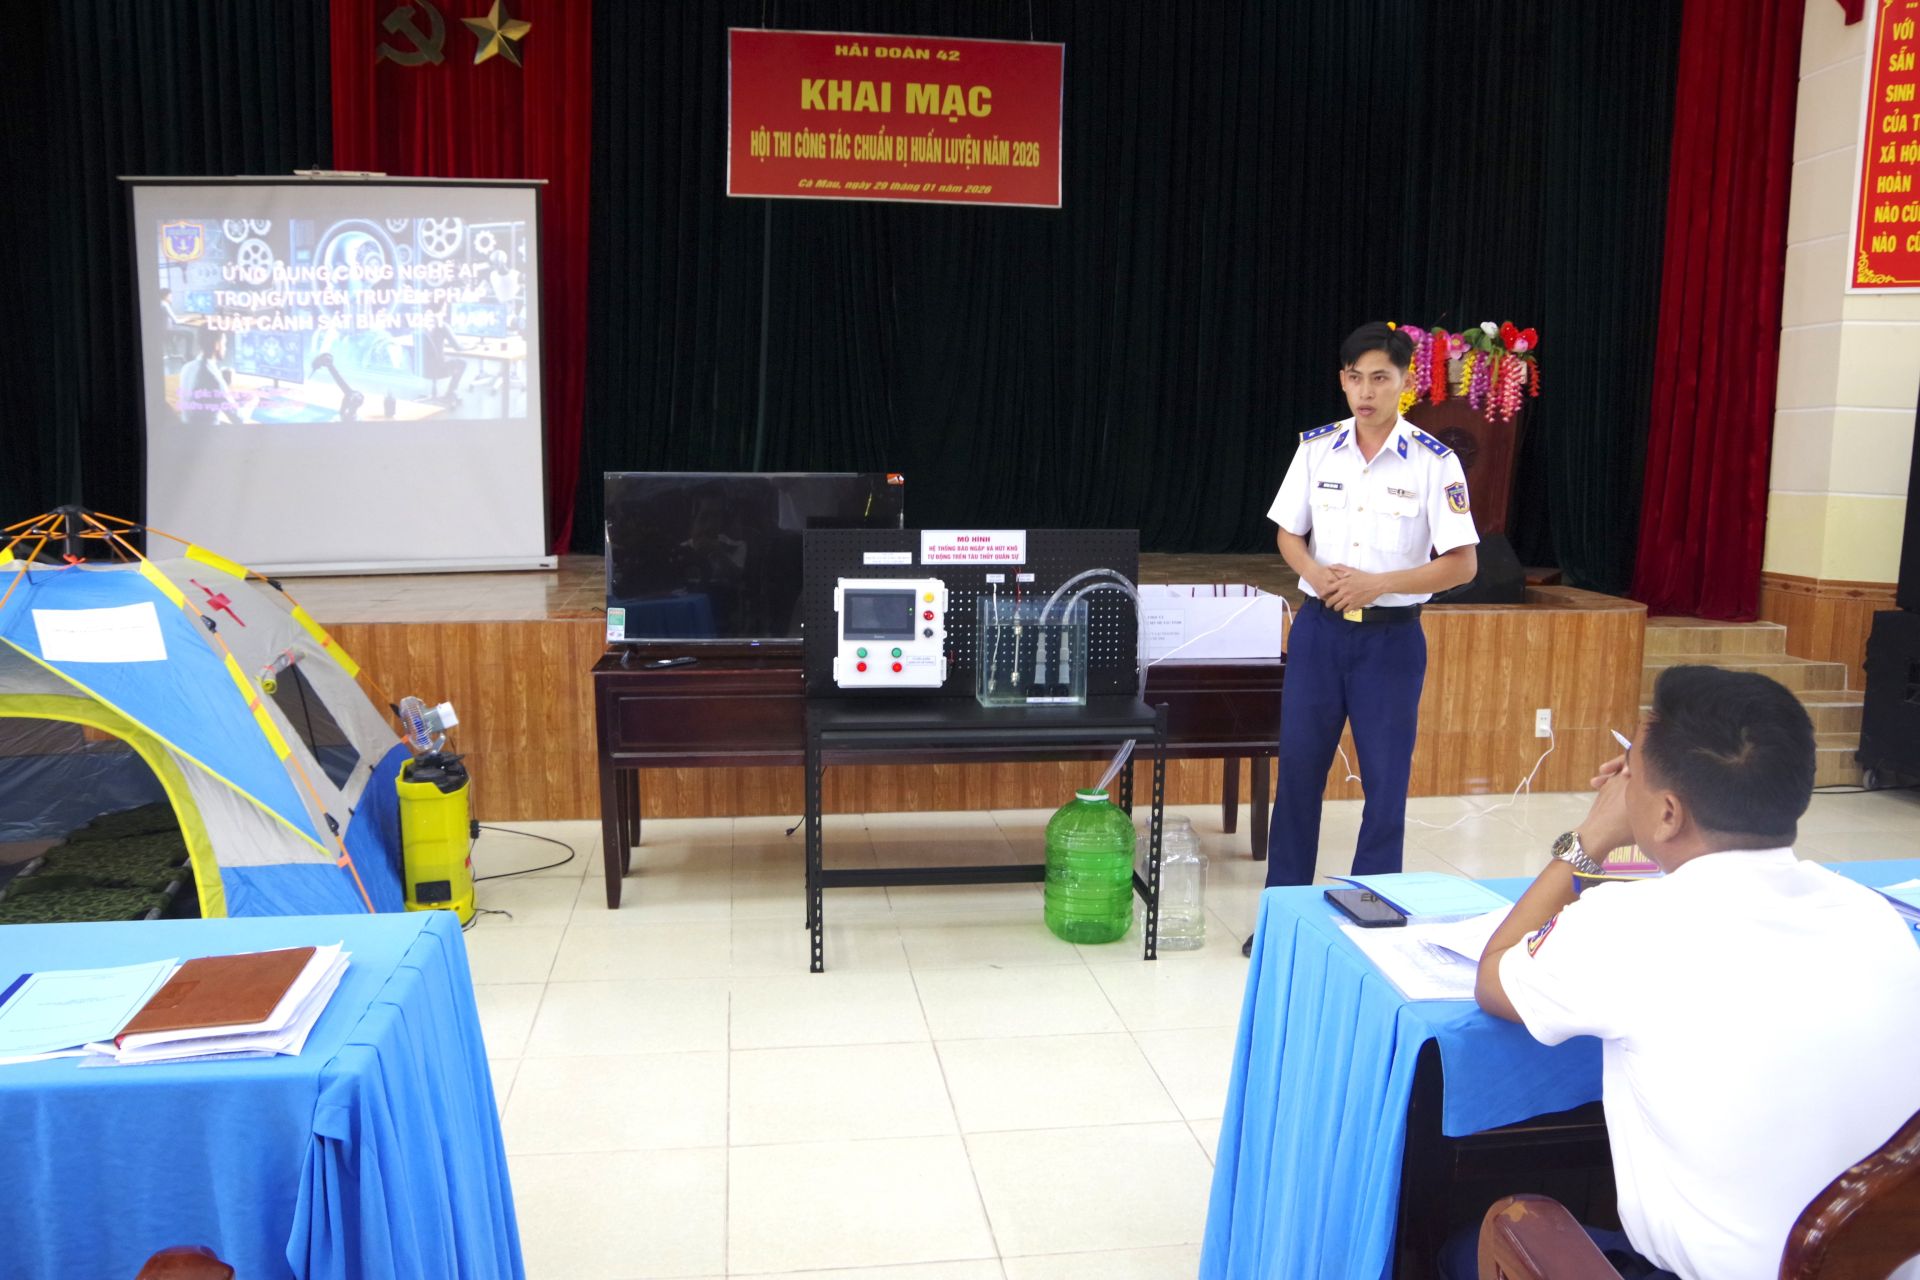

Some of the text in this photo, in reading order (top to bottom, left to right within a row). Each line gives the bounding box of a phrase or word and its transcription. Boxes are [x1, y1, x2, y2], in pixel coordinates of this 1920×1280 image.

[1893, 16, 1915, 41] VỚI
[875, 46, 930, 60] ĐOÀN
[936, 50, 960, 61] 42
[801, 78, 992, 123] KHAI MẠC
[1885, 83, 1915, 103] SINH
[1882, 108, 1908, 133] CỦA
[750, 124, 1040, 170] HỘI THI CÔNG TÁC CHUẨN BỊ HUẤN LUYỆN NĂM 2026
[1879, 141, 1896, 163] XÃ
[922, 183, 936, 192] 01
[1877, 170, 1912, 193] HOÀN
[1874, 201, 1899, 223] NÀO
[1872, 230, 1897, 253] NÀO
[214, 290, 281, 307] TRONG
[256, 311, 313, 331] CẢNH
